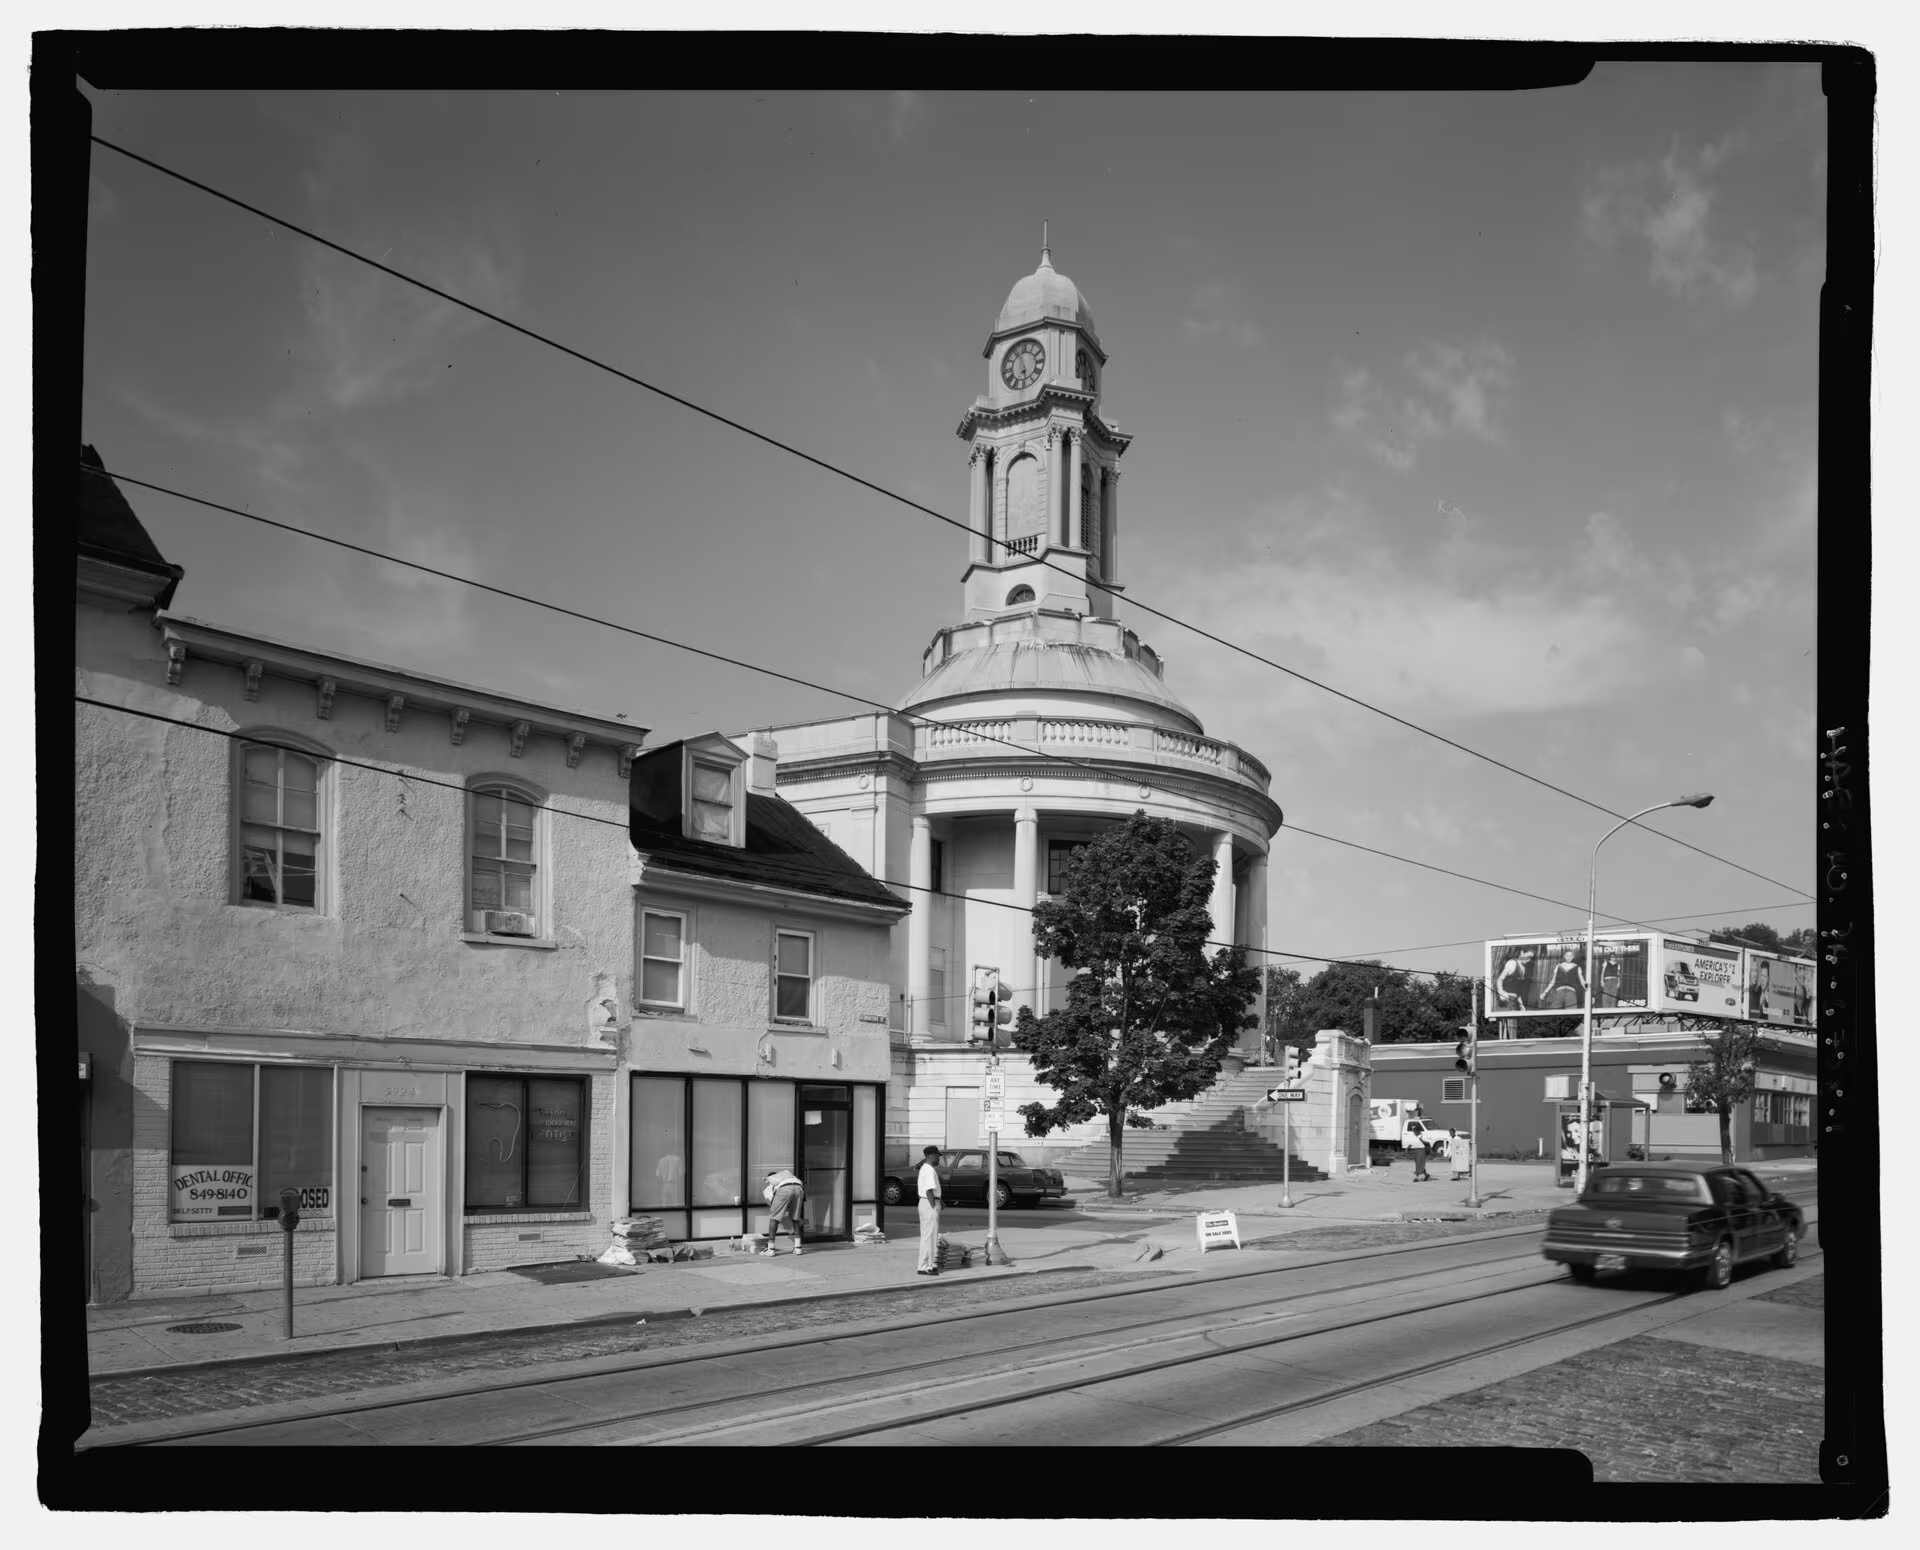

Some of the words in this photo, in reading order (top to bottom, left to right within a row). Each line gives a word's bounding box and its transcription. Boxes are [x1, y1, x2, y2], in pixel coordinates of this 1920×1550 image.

[1694, 958, 1728, 973] AMERICA'S
[1699, 970, 1730, 984] EXPLORER
[1617, 999, 1645, 1008] SEARS
[173, 1169, 221, 1192] DENTAL
[222, 1169, 253, 1188] OFFIC
[300, 1187, 330, 1209] OSED
